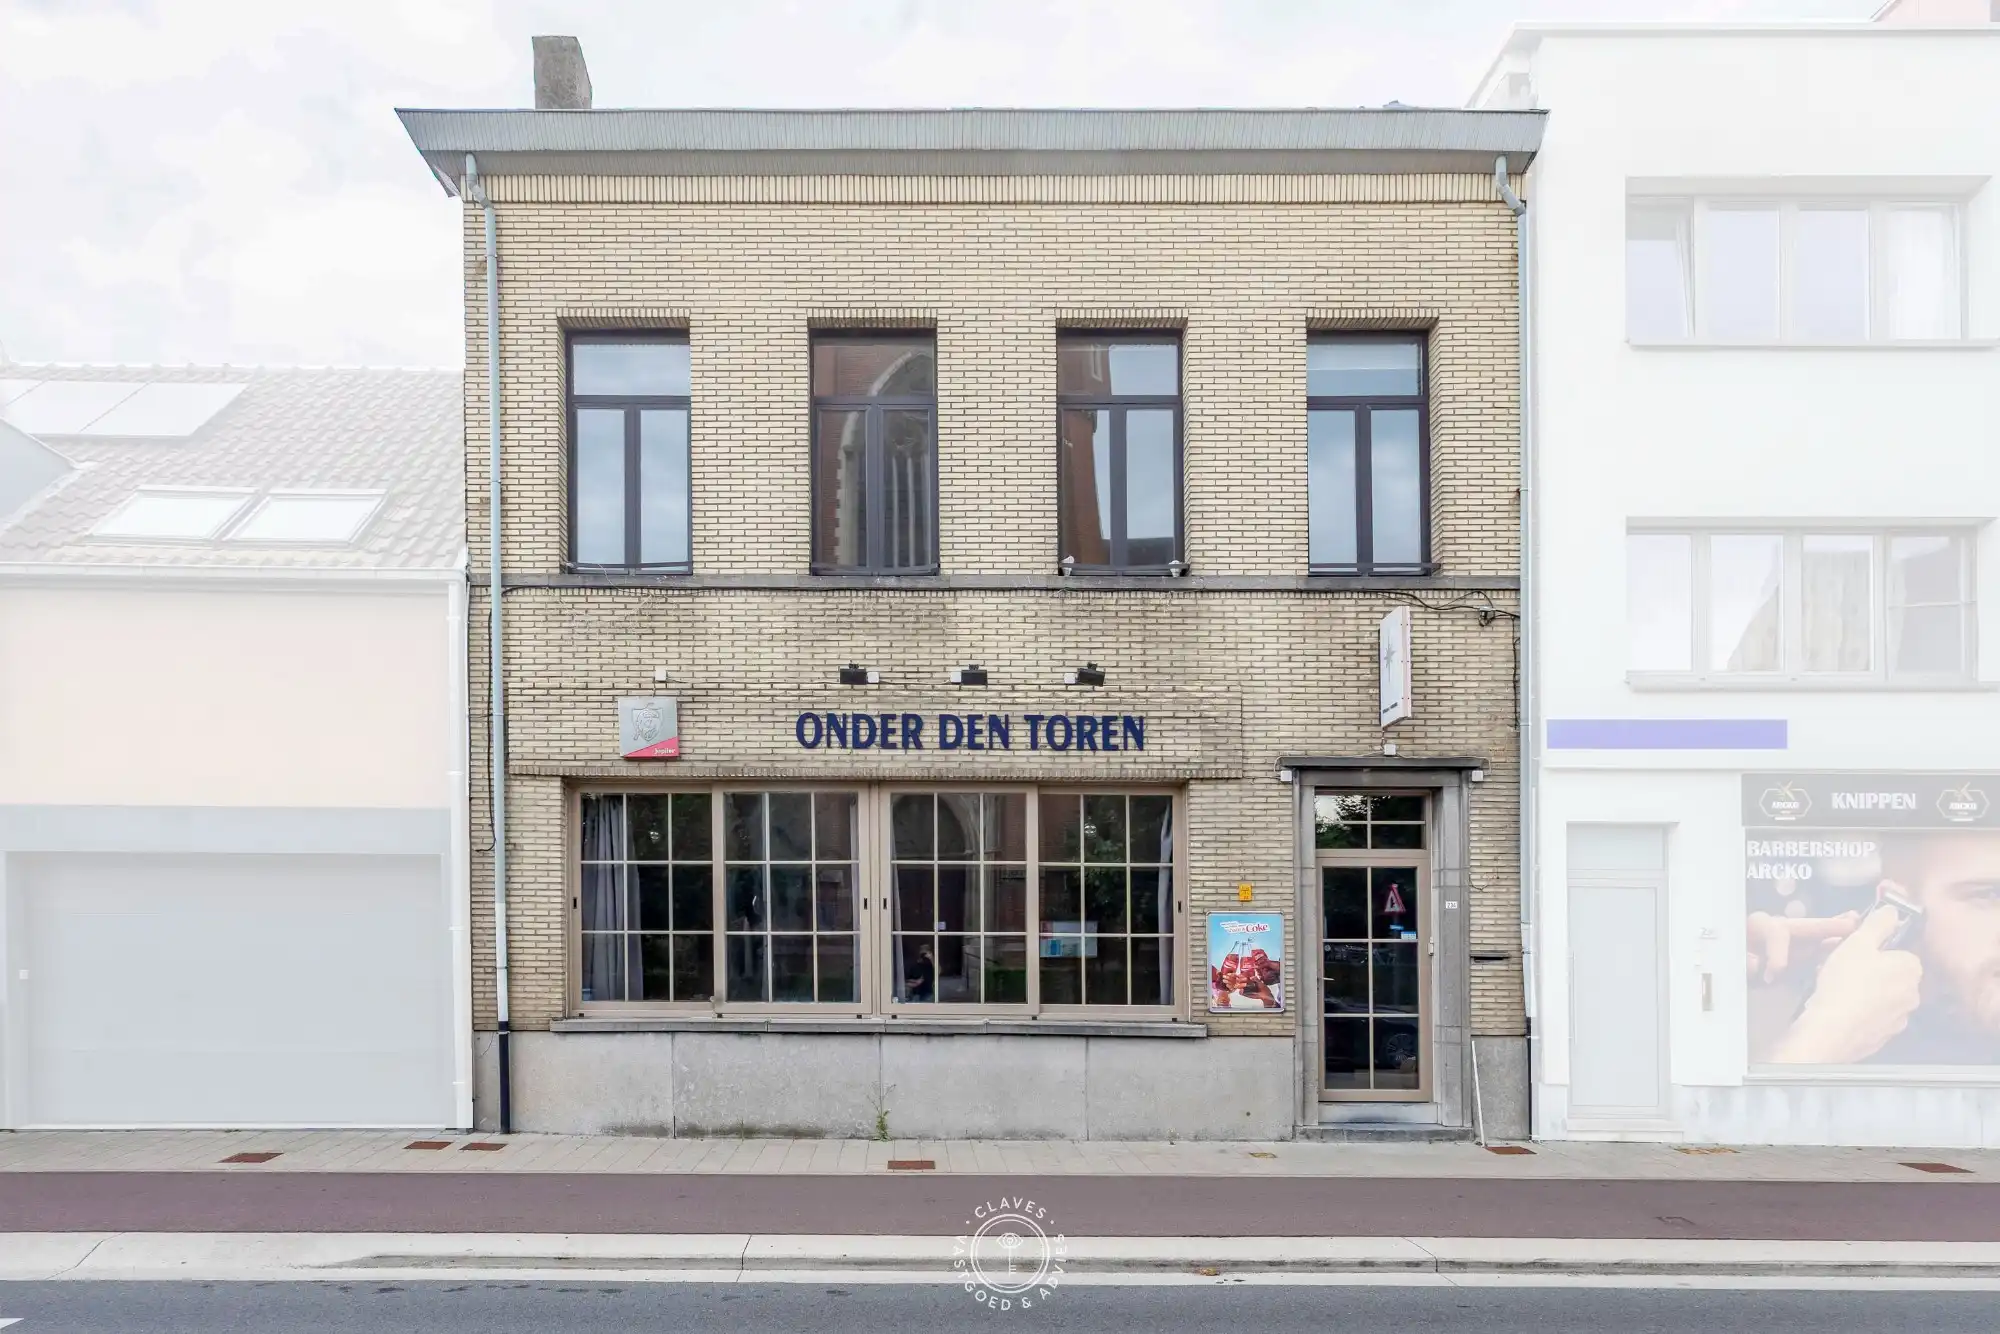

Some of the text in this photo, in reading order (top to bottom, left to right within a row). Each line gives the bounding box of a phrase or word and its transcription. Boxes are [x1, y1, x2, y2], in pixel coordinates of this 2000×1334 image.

[797, 713, 1144, 750] ONDER DEN TOREN
[1831, 792, 1917, 810] KNIPPEN
[1746, 840, 1876, 857] BARBERSHOP
[1746, 862, 1812, 880] ARCKO
